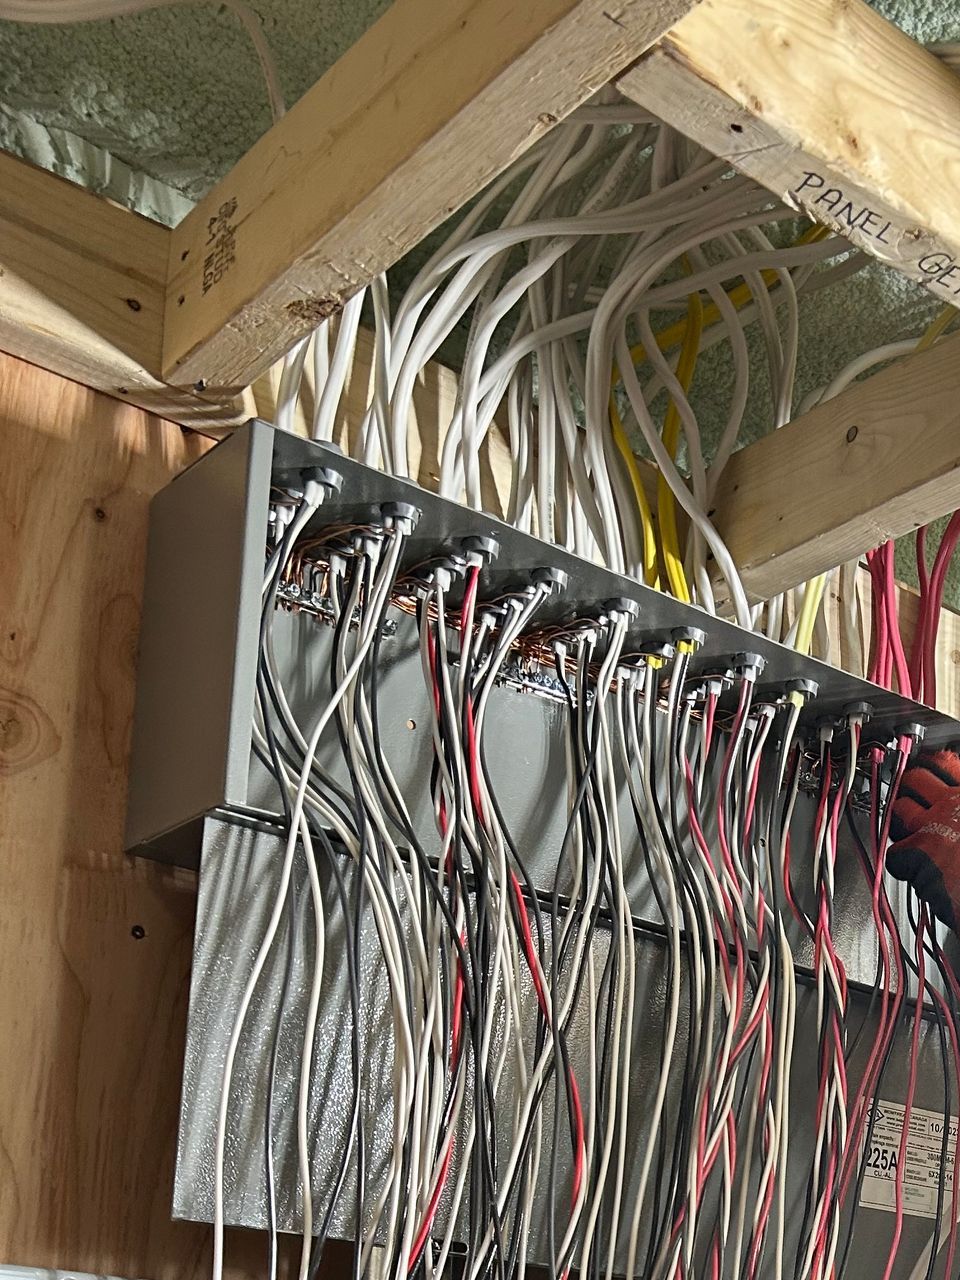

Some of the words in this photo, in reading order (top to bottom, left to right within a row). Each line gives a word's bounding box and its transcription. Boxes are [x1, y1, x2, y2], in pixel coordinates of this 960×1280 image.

[795, 171, 892, 244] PANEL
[930, 1122, 959, 1136] 10/02
[866, 1147, 898, 1171] 225A
